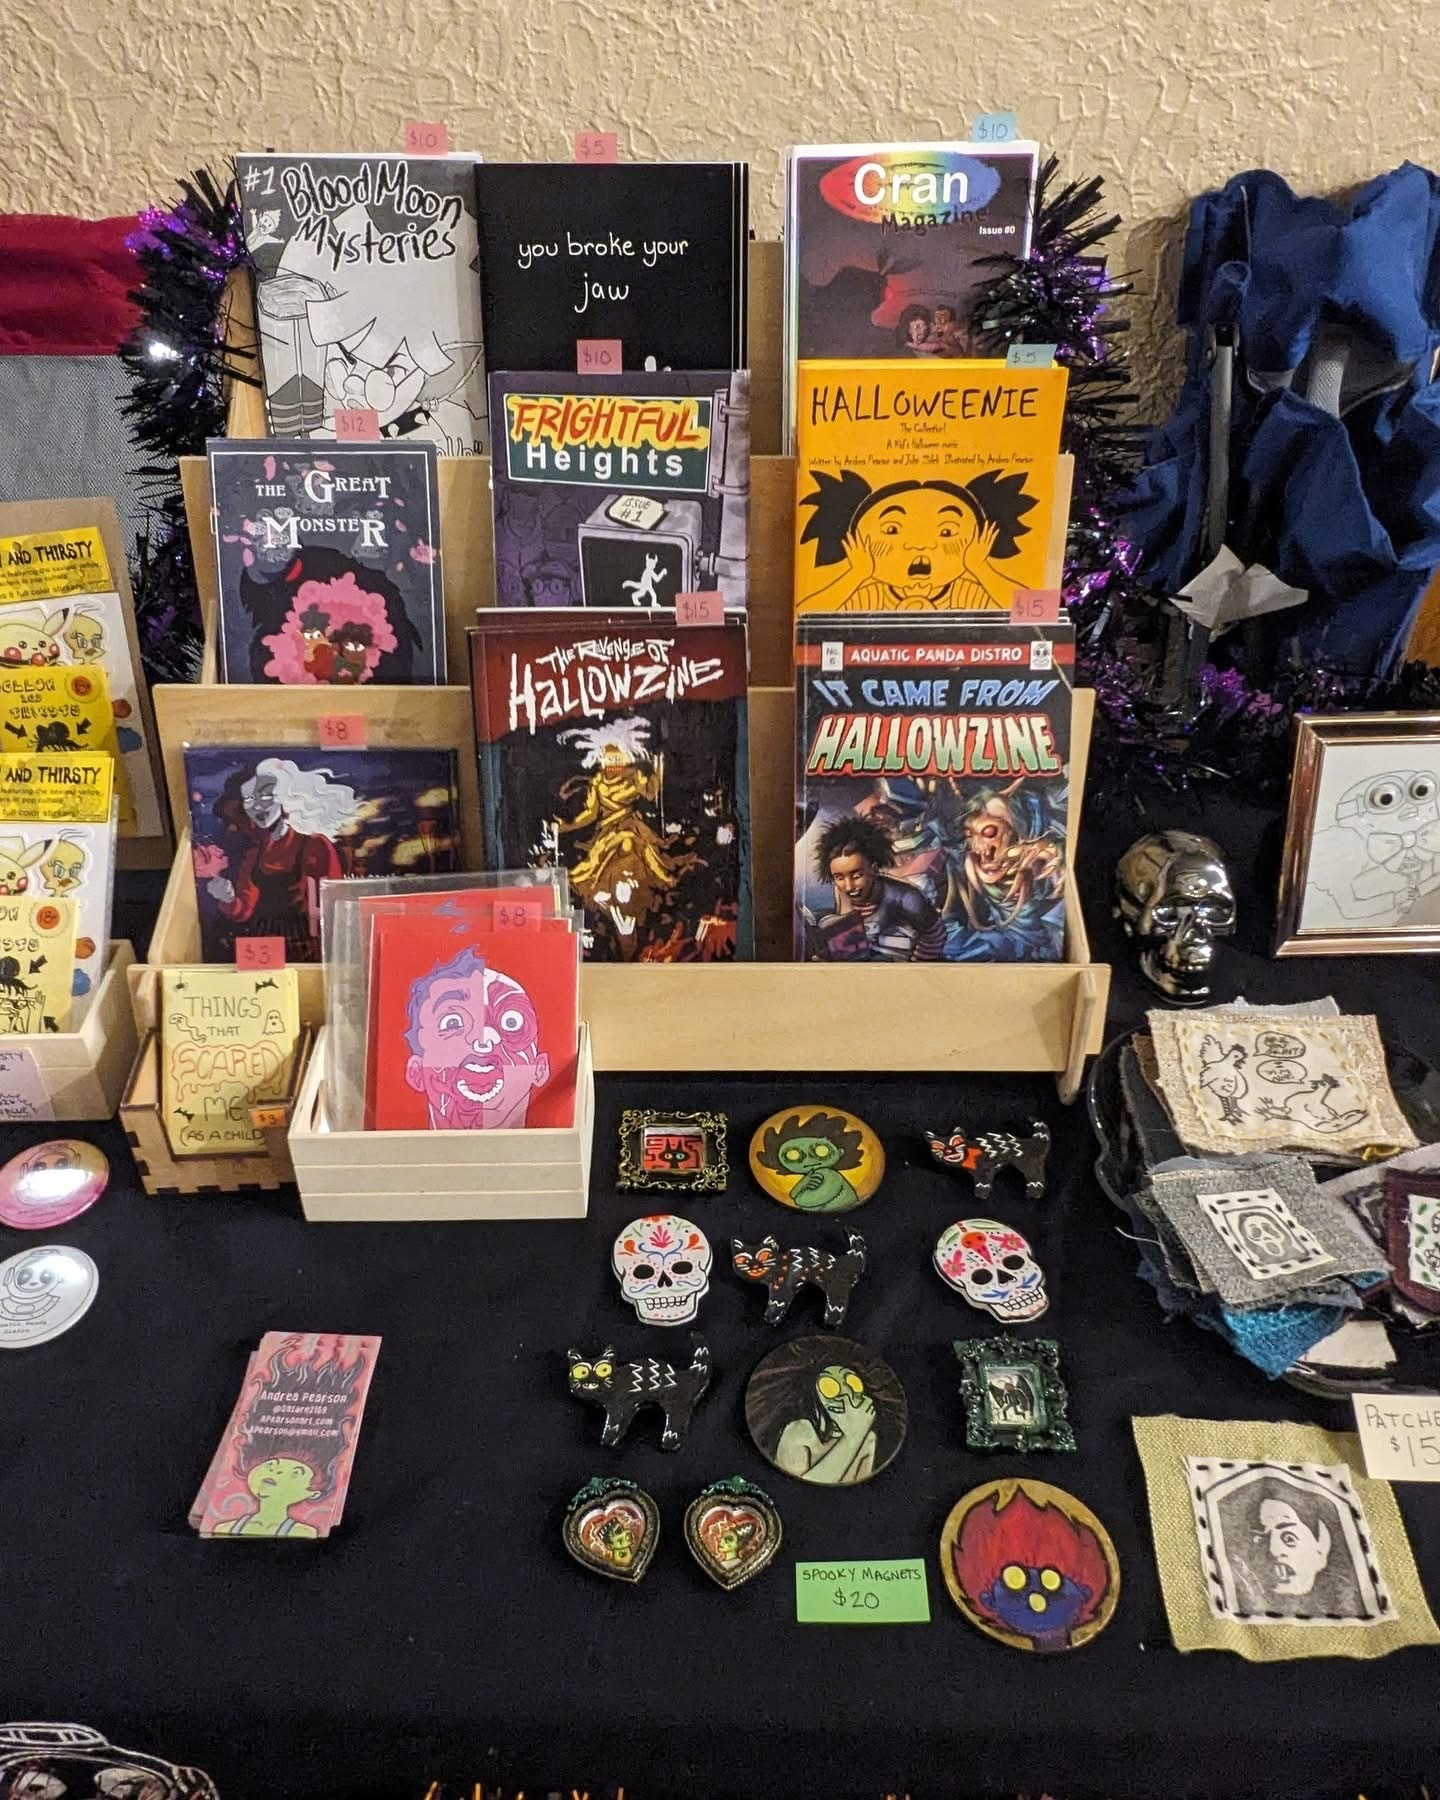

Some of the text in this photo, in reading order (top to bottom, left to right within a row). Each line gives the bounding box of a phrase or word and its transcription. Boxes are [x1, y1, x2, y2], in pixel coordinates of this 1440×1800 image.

[409, 129, 438, 148] $10
[978, 124, 1008, 139] $10
[581, 139, 605, 155] $5
[243, 164, 277, 196] #1
[853, 162, 969, 206] Cran
[281, 160, 465, 229] Blood Moon
[881, 205, 989, 236] Magazine
[979, 225, 1002, 235] Issue
[294, 215, 457, 272] Mysteries
[518, 231, 689, 269] you broke your
[574, 272, 629, 313] jaw
[582, 350, 612, 366] $10
[1011, 350, 1037, 363] $5
[811, 384, 1039, 426] HALLOWEENIE
[341, 414, 365, 432] $12
[512, 399, 702, 444] FRIGHTFUL
[526, 441, 684, 480] Heights
[256, 470, 392, 503] THE GREAT
[622, 497, 651, 510] ISSUE
[262, 516, 388, 549] MONSTER
[8, 540, 92, 566] AND THIRSTY
[683, 600, 710, 618] $15
[1015, 599, 1045, 617] $15
[537, 645, 575, 675] THE
[645, 638, 675, 665] OF
[851, 647, 1022, 663] AQUATIC PANDA DISTRO
[812, 679, 1060, 707] IT CAME FROM
[326, 719, 349, 738] $8
[806, 714, 1062, 777] HALLOWZINE
[5, 766, 101, 784] AND THIRSTY
[499, 907, 526, 925] $8
[244, 945, 272, 964] $3
[184, 996, 263, 1019] THINGS
[206, 1025, 241, 1037] THAT
[178, 1047, 279, 1081] SCARED
[203, 1096, 244, 1122] ME
[209, 1130, 221, 1141] A
[260, 1390, 348, 1404] Andrea Pearson
[1364, 1403, 1440, 1429] PATCHE
[1390, 1434, 1440, 1468] $15
[802, 1567, 921, 1582] SPOOKY MAGNETS
[832, 1587, 880, 1609] $20
